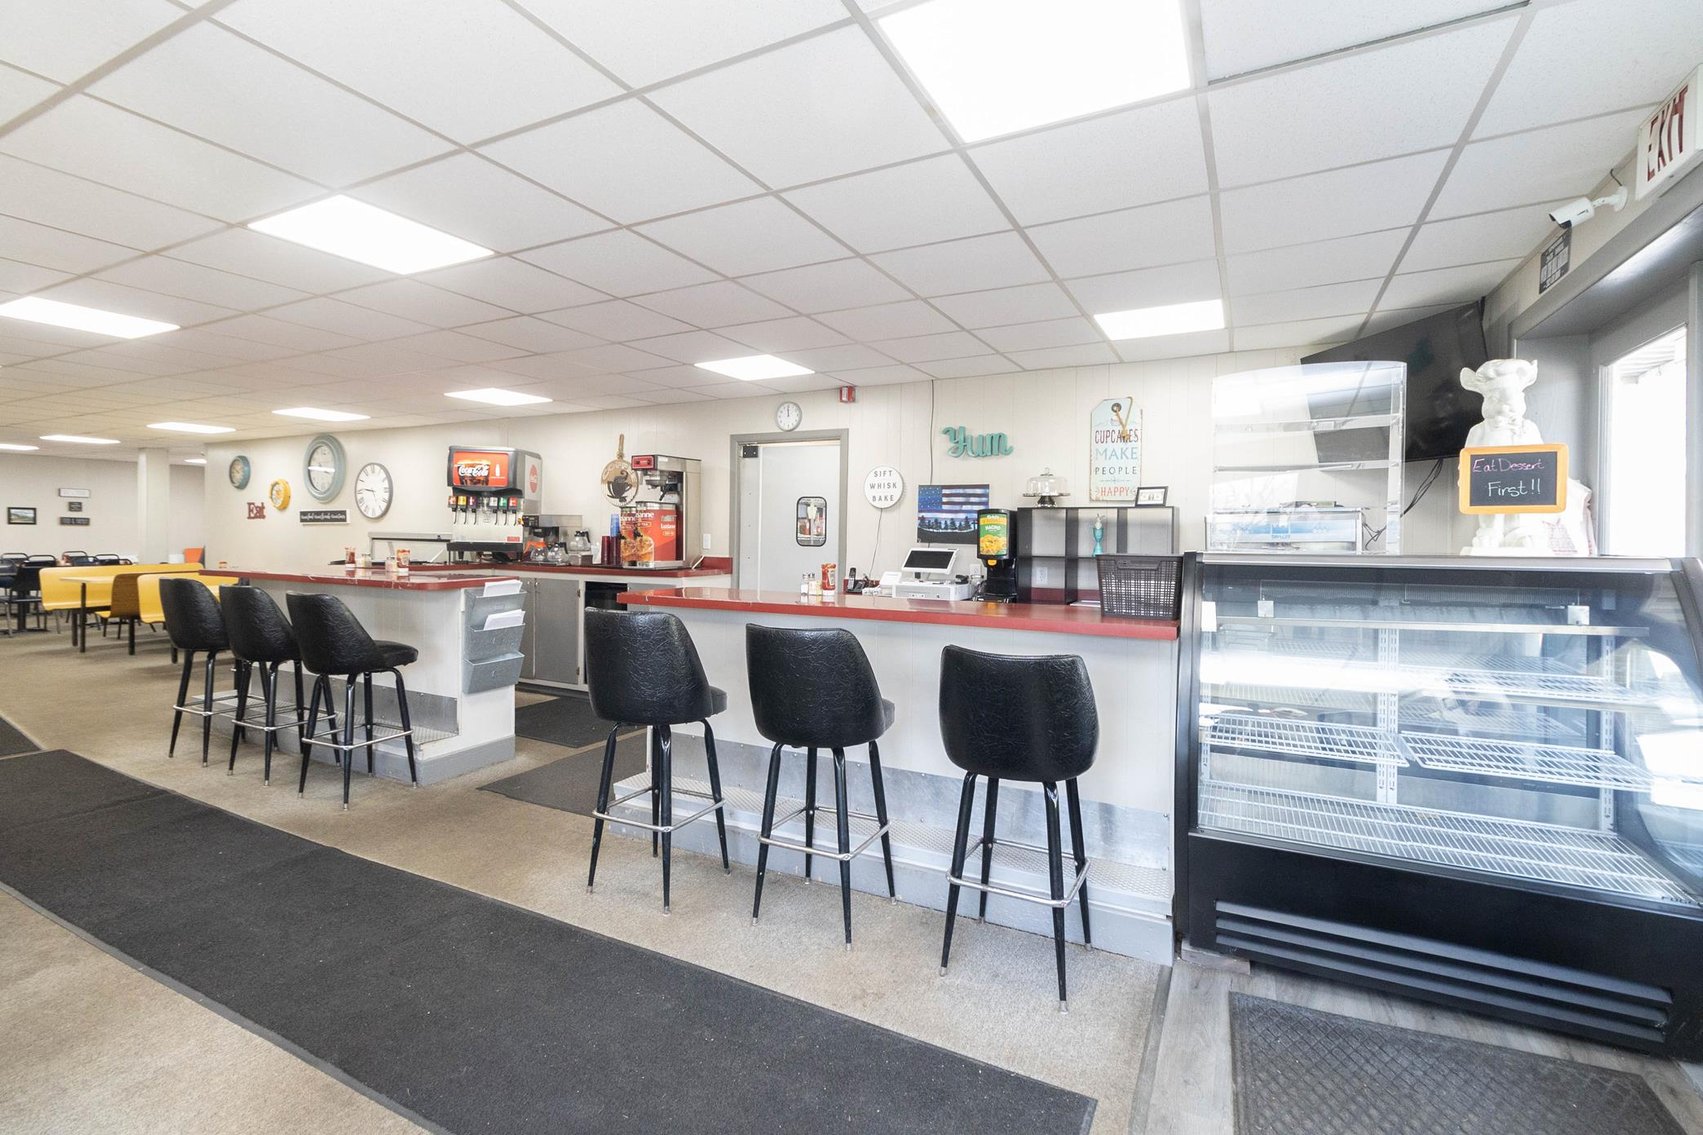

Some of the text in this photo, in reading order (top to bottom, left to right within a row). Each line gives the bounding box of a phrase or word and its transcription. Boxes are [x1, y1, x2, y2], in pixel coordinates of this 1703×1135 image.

[1646, 84, 1688, 182] EXIT
[942, 425, 1014, 458] Yum
[1095, 447, 1138, 461] MAKE
[1094, 466, 1137, 475] PEOPLE
[1472, 458, 1544, 472] Eat Dessert
[873, 470, 893, 478] SIFT
[869, 482, 898, 490] WHISK
[1100, 486, 1130, 497] HAPPY
[872, 494, 895, 502] BAKE
[247, 502, 266, 519] Eat
